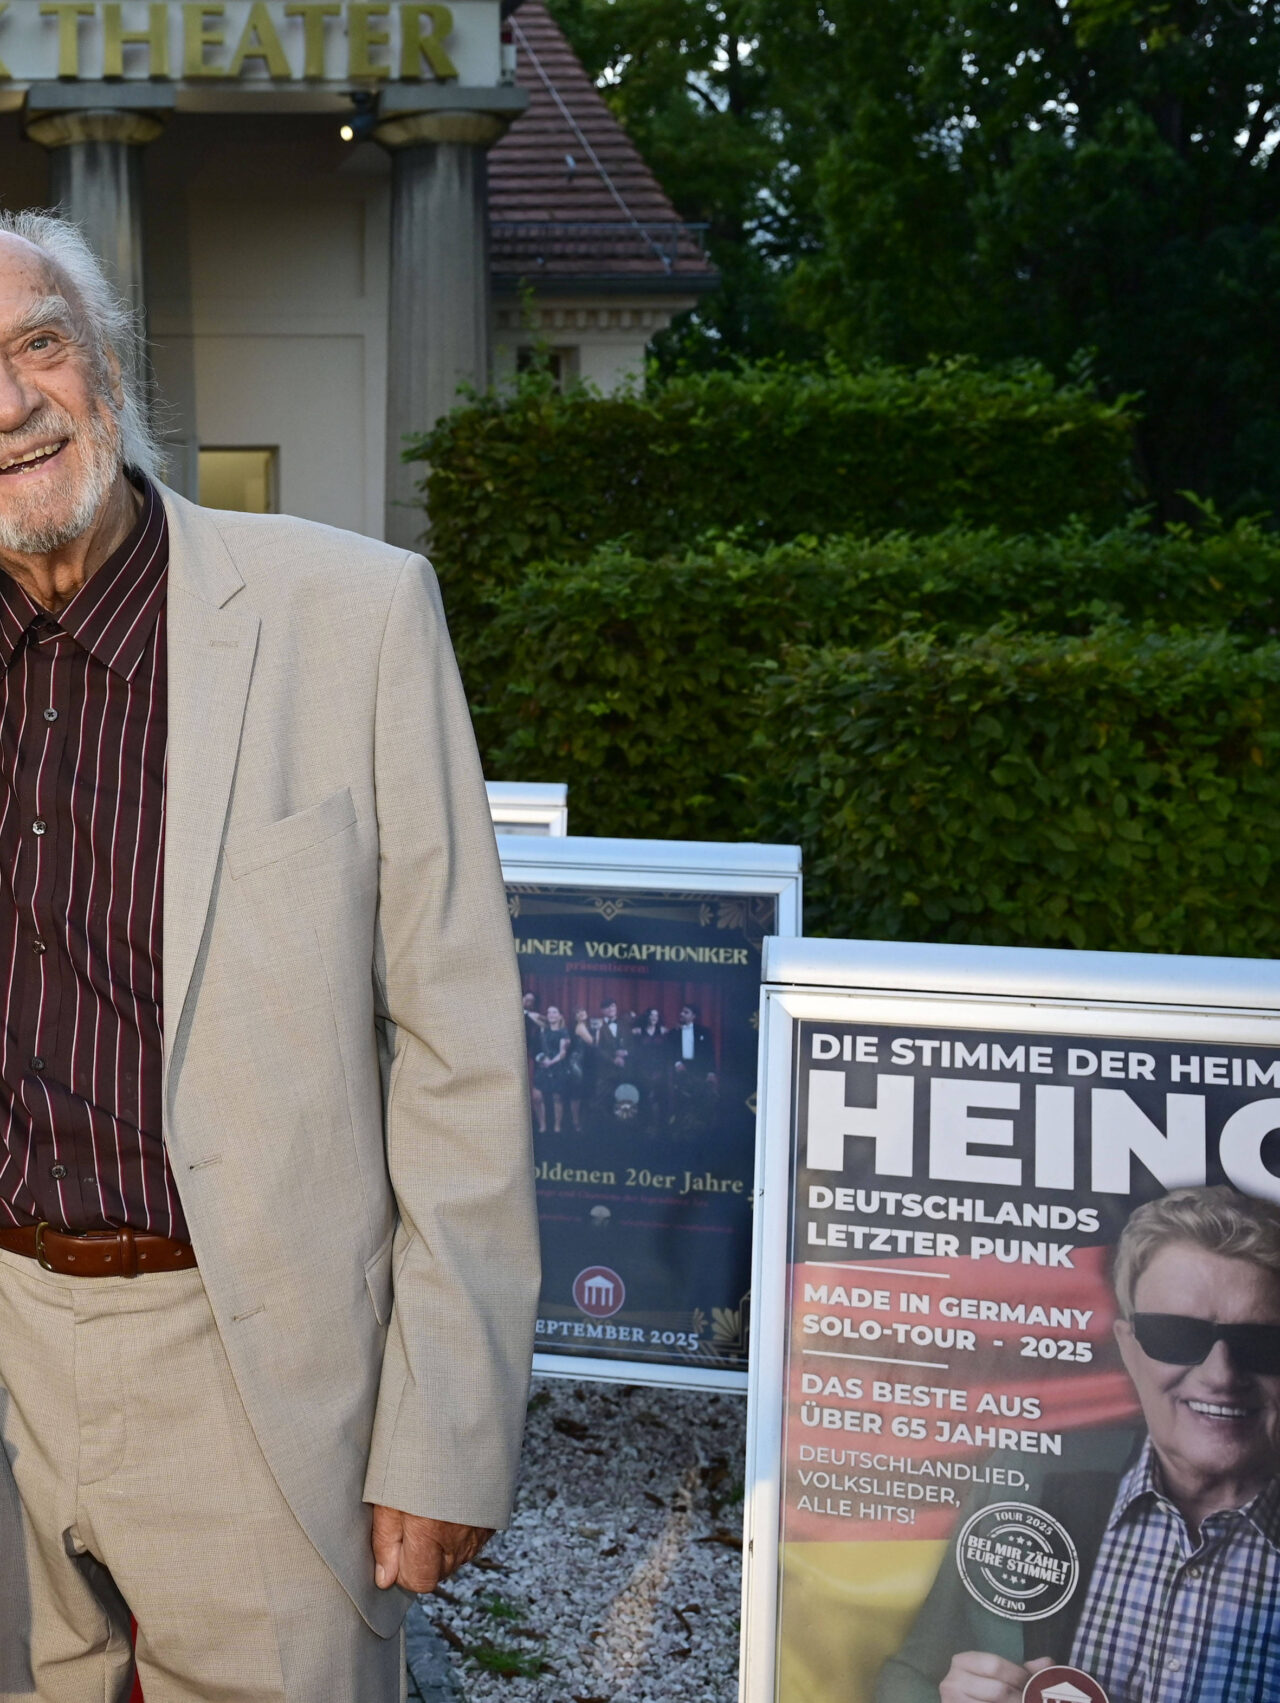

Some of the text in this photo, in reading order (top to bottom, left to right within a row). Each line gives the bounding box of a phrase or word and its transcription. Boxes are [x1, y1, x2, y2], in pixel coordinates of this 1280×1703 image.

[39, 2, 459, 80] THEATER
[811, 1033, 1280, 1088] DIE STIMME DER HEIM
[625, 1168, 676, 1188] 20er
[680, 1171, 744, 1194] Jahre
[808, 1185, 1100, 1233] DEUTSCHLANDS
[807, 1222, 1074, 1268] LETZTER PUNK
[804, 1284, 1093, 1330] MADE IN GERMANY
[650, 1331, 699, 1350] 2025
[802, 1314, 975, 1351] SOLO-TOUR
[1020, 1336, 1093, 1363] 2025
[801, 1373, 1041, 1419] DAS BESTE AUS
[800, 1400, 1062, 1456] ÜBER 65 JAHREN
[797, 1470, 961, 1508] VOLKSLIEDER,
[799, 1445, 1030, 1492] DEUTSCHLANDLIED,
[797, 1495, 916, 1525] ALLE HITS!
[995, 1511, 1053, 1535] TOUR 2025
[966, 1547, 1066, 1585] EURE STIMME!
[967, 1534, 1070, 1574] BEI MIR ZÄHLT
[993, 1594, 1026, 1611] HEINO
